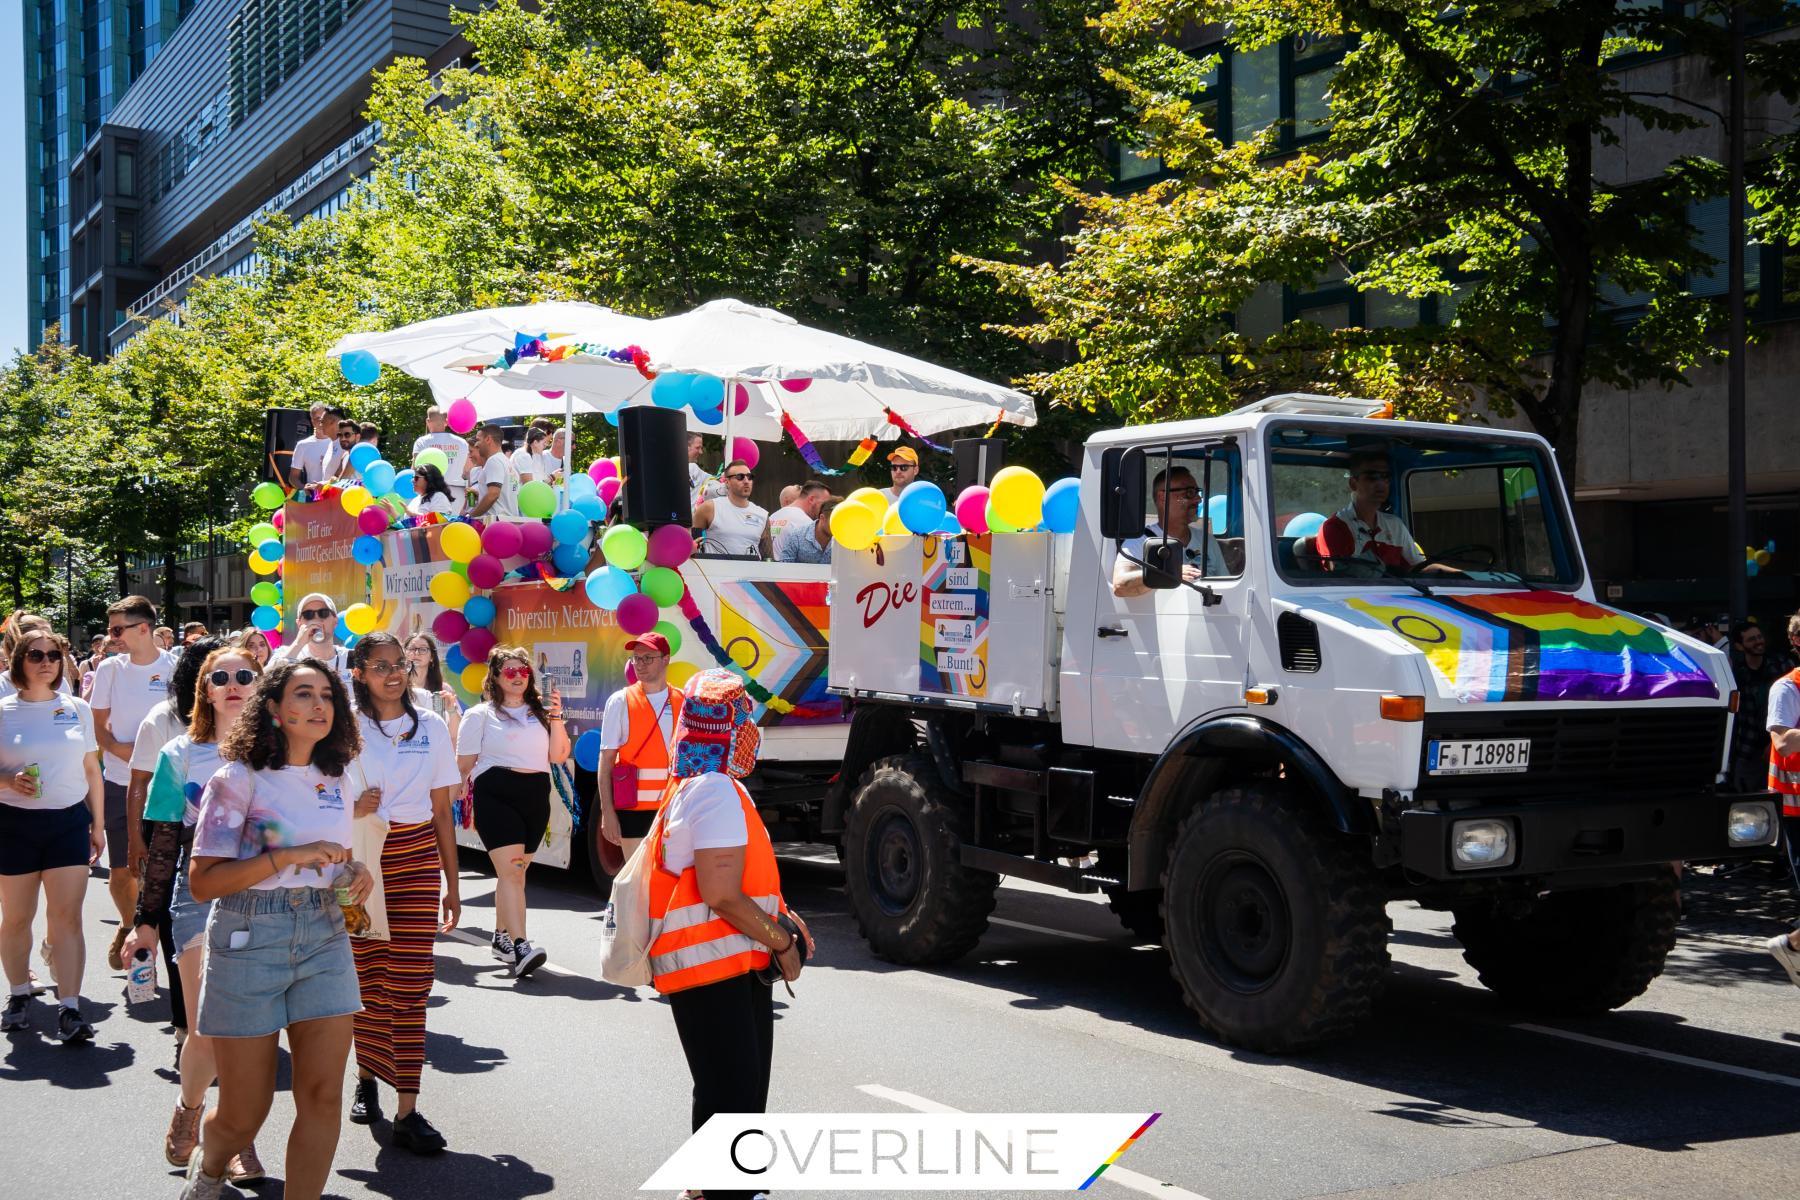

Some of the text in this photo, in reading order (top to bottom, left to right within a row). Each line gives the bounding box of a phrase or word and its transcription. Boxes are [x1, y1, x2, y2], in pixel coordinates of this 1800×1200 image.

[307, 520, 333, 540] Für eine
[296, 538, 355, 563] bunte Gesellscha
[386, 573, 402, 594] Wir
[403, 569, 423, 593] sind
[948, 571, 969, 586] sind
[856, 582, 918, 628] Die
[931, 596, 973, 611] extrem...
[507, 605, 619, 636] Diversity Netzwer
[938, 655, 973, 672] ...Bunt!
[1439, 744, 1451, 766] F
